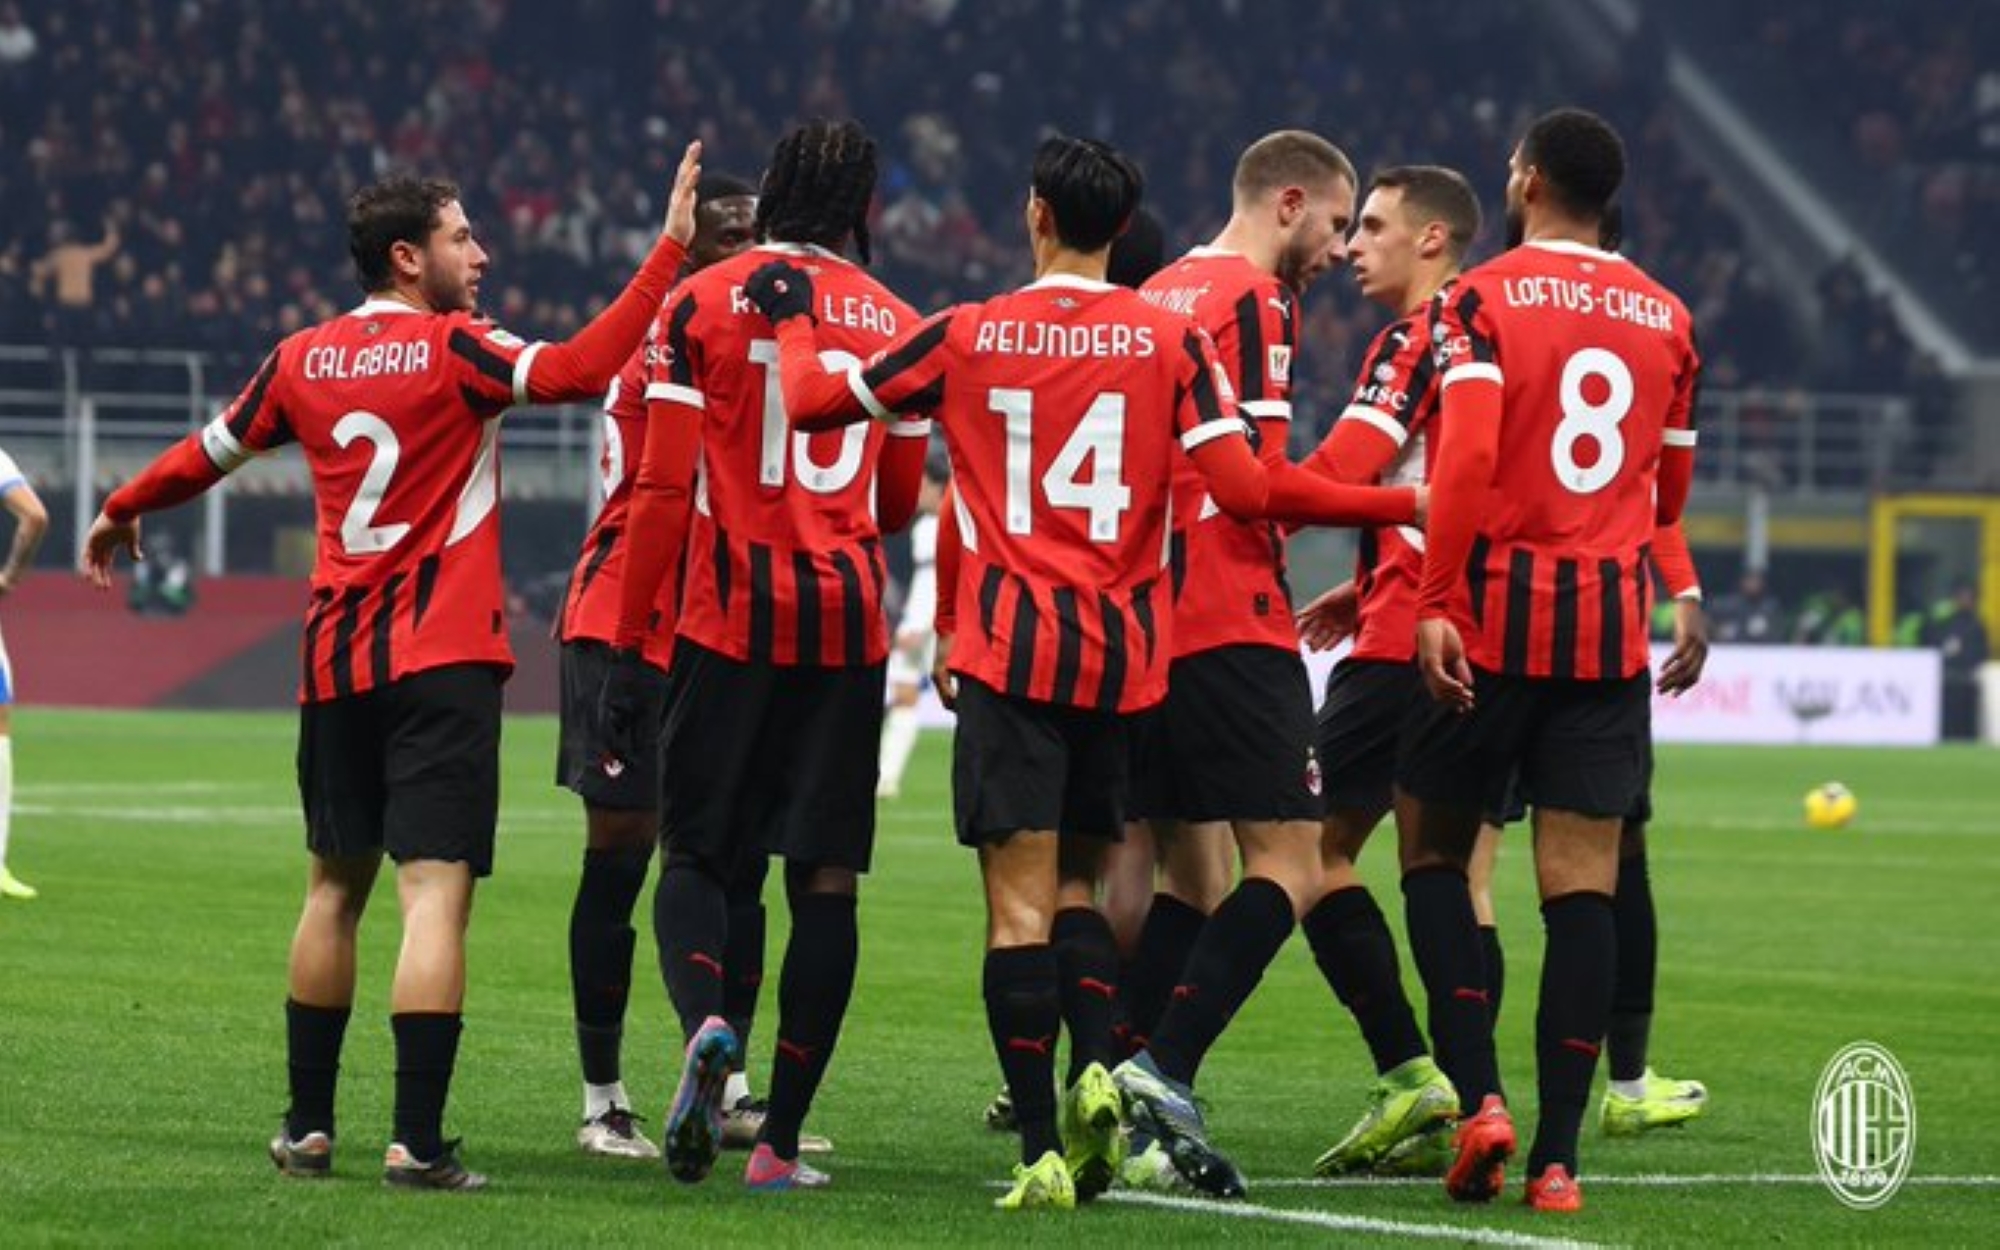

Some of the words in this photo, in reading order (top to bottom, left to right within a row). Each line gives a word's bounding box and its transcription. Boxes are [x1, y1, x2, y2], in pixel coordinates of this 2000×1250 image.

[823, 294, 897, 338] LEÃO
[1504, 277, 1673, 332] LOFTUS-CHEEK
[305, 340, 429, 381] CALABRIA
[644, 344, 675, 367] SC
[975, 320, 1155, 358] REIJNDERS
[1551, 347, 1635, 494] 8
[331, 410, 411, 555] 2
[987, 387, 1132, 543] 14
